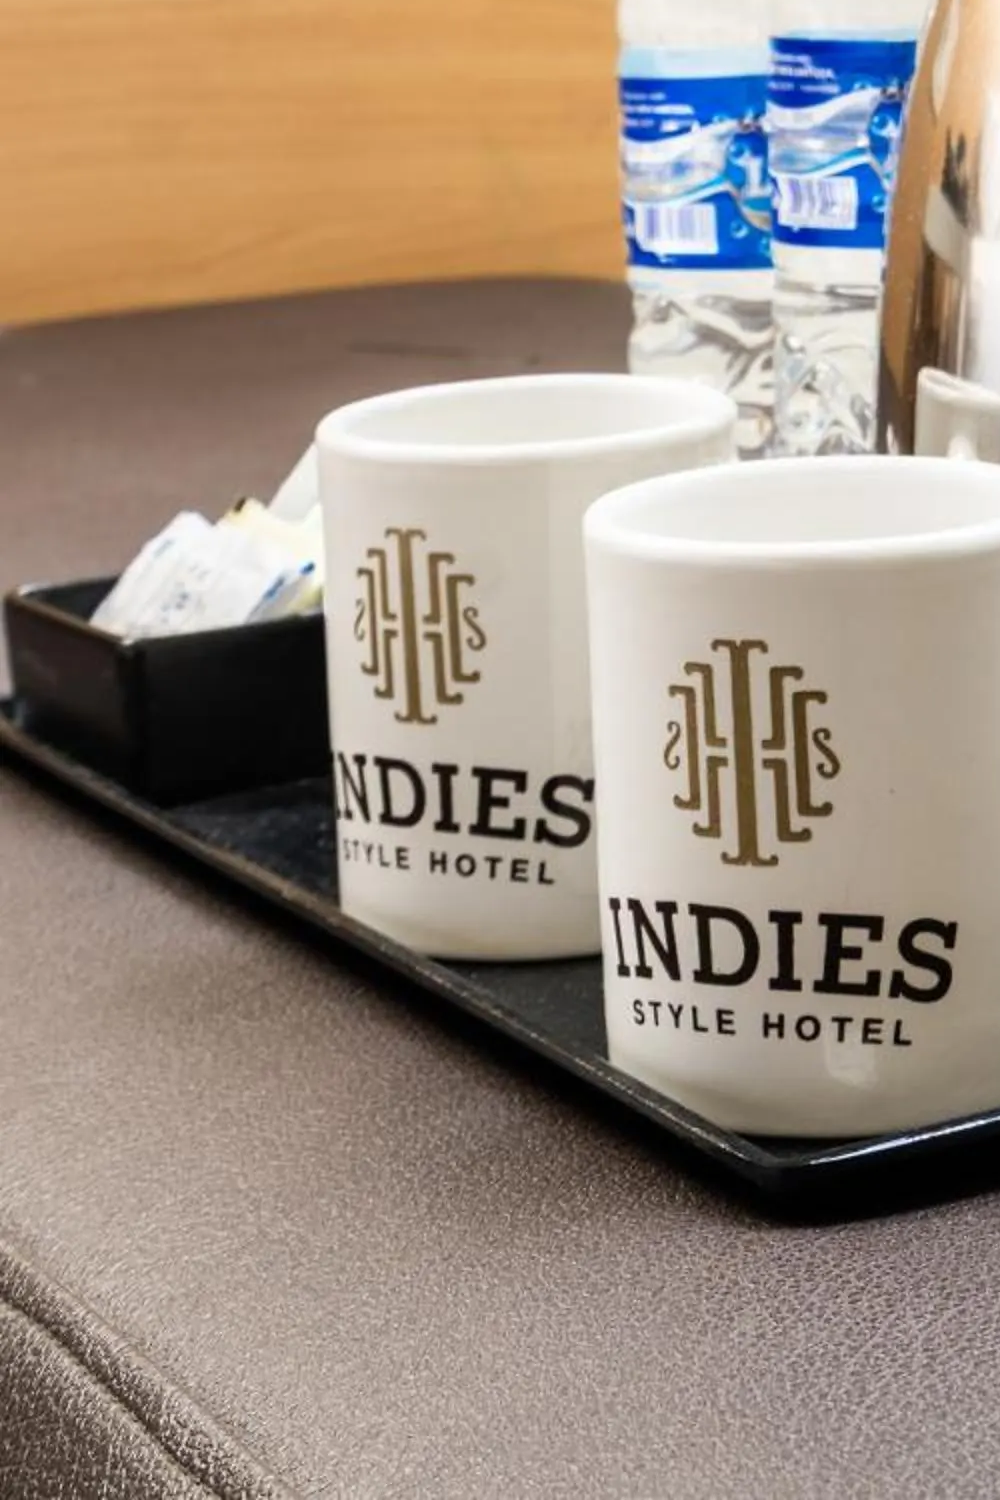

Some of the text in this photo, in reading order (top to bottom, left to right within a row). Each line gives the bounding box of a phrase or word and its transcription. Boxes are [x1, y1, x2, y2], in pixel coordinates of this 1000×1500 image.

[336, 751, 596, 849] NDIES
[343, 838, 556, 886] STYLE HOTEL
[608, 897, 959, 1004] INDIES
[632, 999, 913, 1047] STYLE HOTEL
